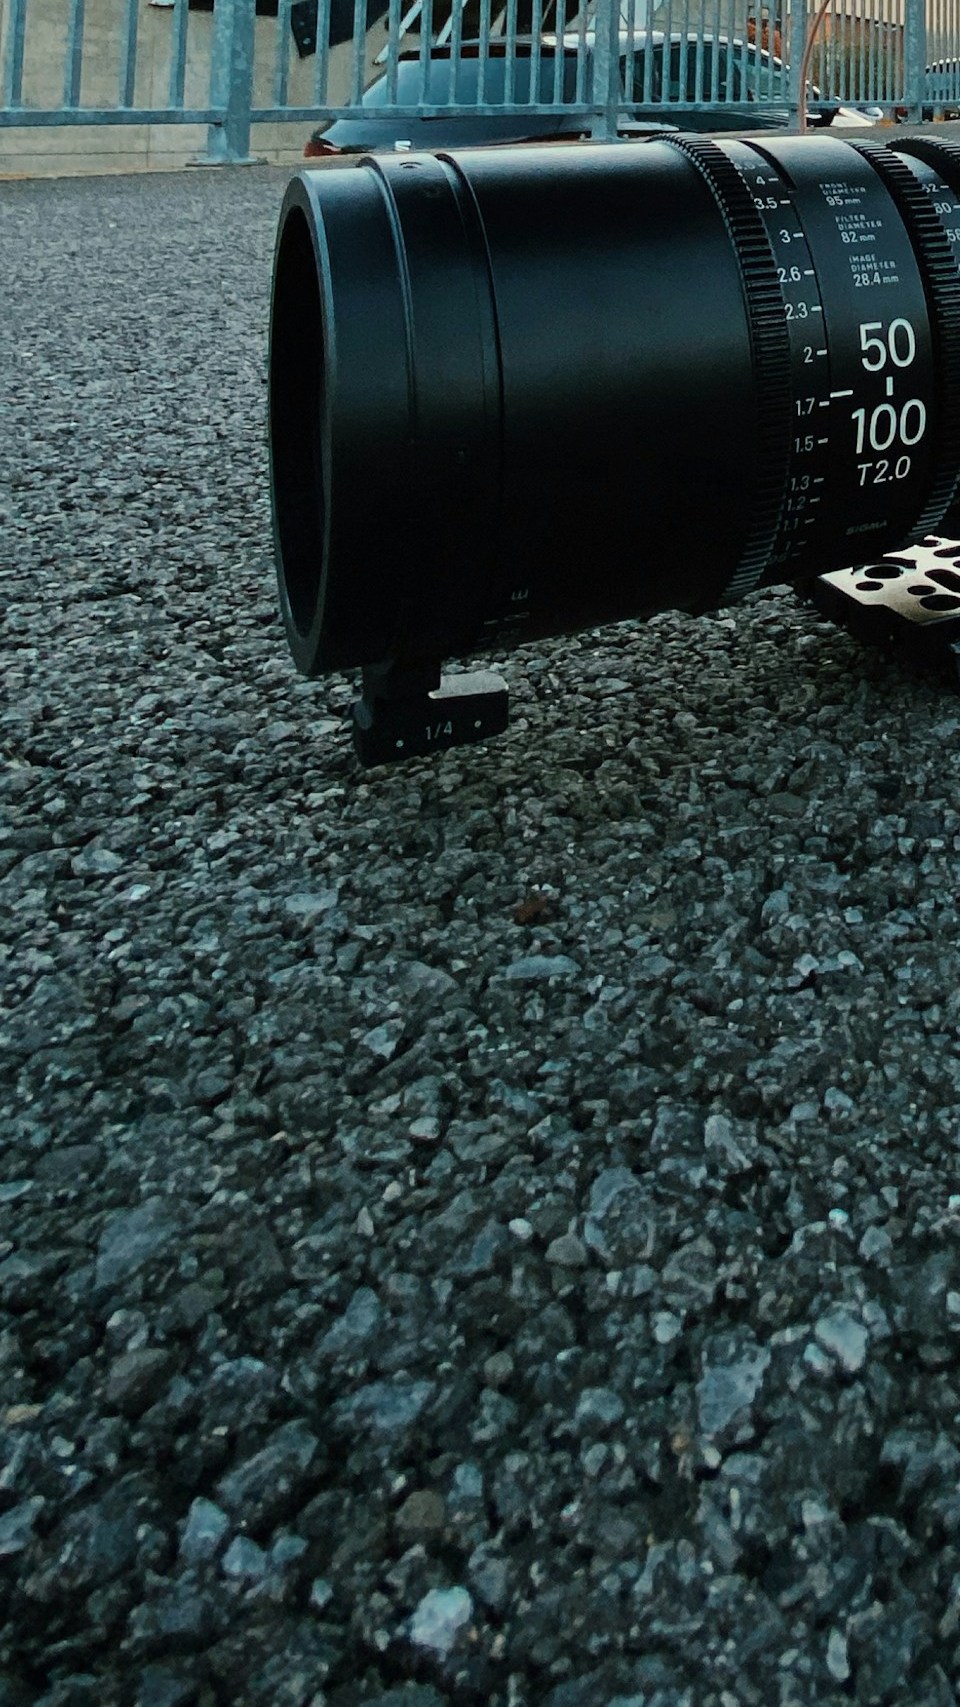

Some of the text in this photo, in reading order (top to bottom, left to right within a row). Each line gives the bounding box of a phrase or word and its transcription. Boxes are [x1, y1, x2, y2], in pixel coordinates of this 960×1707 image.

[756, 176, 766, 185] 4
[819, 182, 847, 190] FRONT
[822, 187, 866, 197] DIAMETER
[753, 197, 778, 210] 3.5
[826, 196, 862, 207] 95 mm
[835, 214, 866, 223] FILTER
[838, 221, 882, 232] DIAMETER
[779, 229, 791, 244] 3
[841, 231, 876, 244] 82 mm
[849, 254, 876, 263] IMAGE
[851, 261, 896, 273] DIAMETER
[777, 266, 802, 284] 2.6
[853, 271, 900, 288] 28.4 mm
[784, 302, 809, 321] 2.3
[859, 318, 916, 372] 50
[803, 346, 814, 363] 2
[795, 397, 815, 416] 1.7
[851, 398, 927, 454] 100
[794, 435, 814, 453] 1.5
[857, 455, 911, 487] T2.0
[790, 474, 810, 492] 1.3
[845, 518, 889, 536] SIGMA
[425, 720, 453, 741] 1/4
